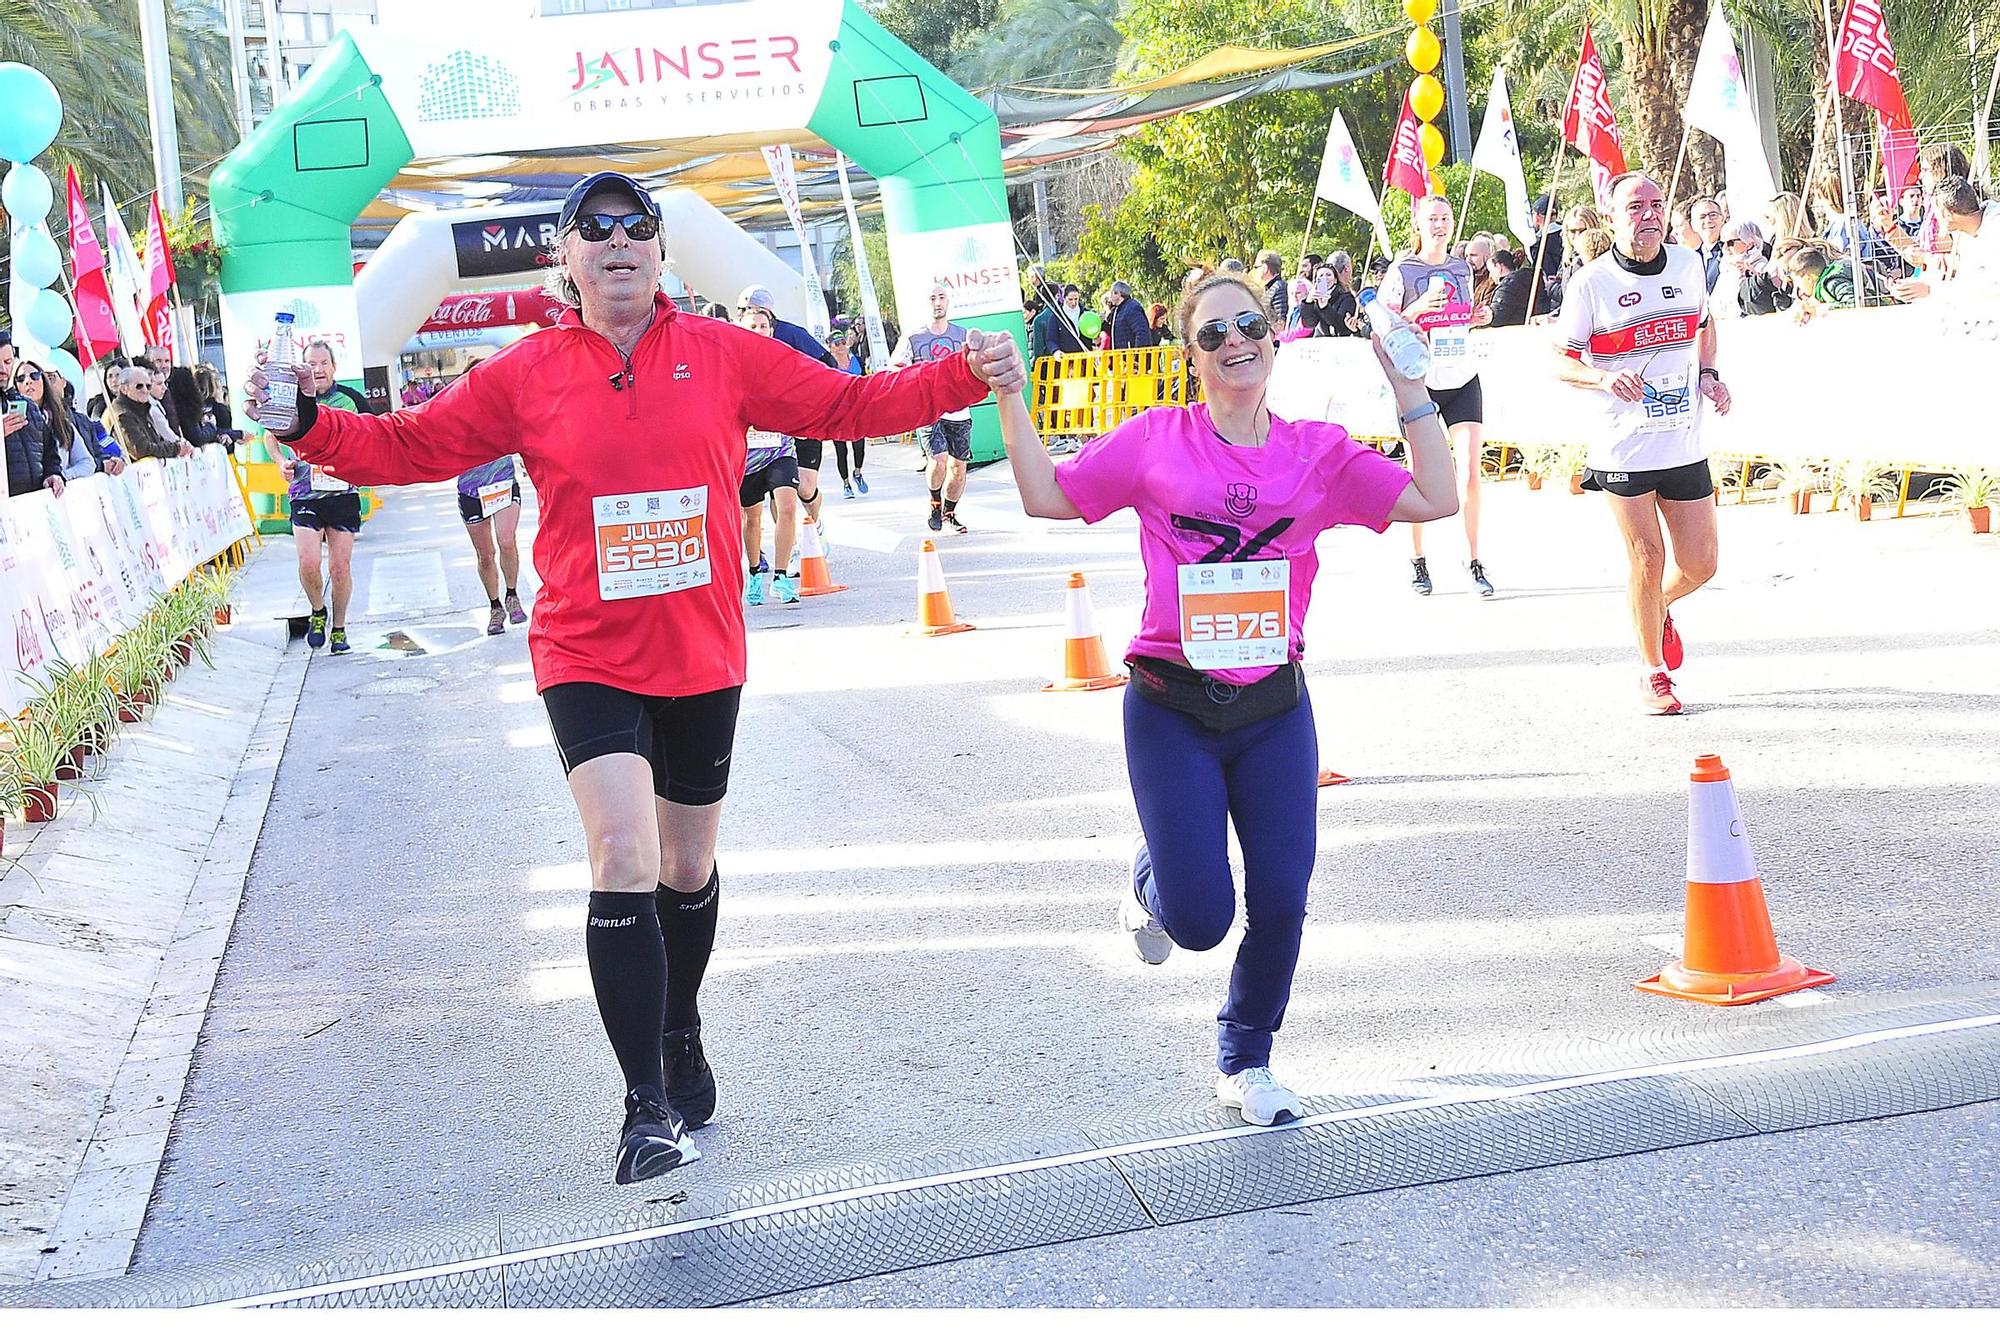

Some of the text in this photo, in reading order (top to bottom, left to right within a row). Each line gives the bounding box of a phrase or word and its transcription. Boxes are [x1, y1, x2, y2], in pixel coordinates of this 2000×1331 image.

[571, 36, 802, 90] JAINSER
[574, 83, 806, 113] OBRAS Y SERVICIOS
[1419, 312, 1450, 325] MEDIA
[1633, 321, 1687, 341] ELCHE
[1634, 331, 1688, 347] DECATLON
[1433, 346, 1466, 357] 2395
[1644, 399, 1690, 419] 1582
[620, 520, 688, 542] JULIAN
[606, 536, 701, 572] 5230
[1190, 611, 1280, 641] 5376
[679, 879, 719, 911] SPORTLAST
[590, 915, 638, 928] SPORTLAST
